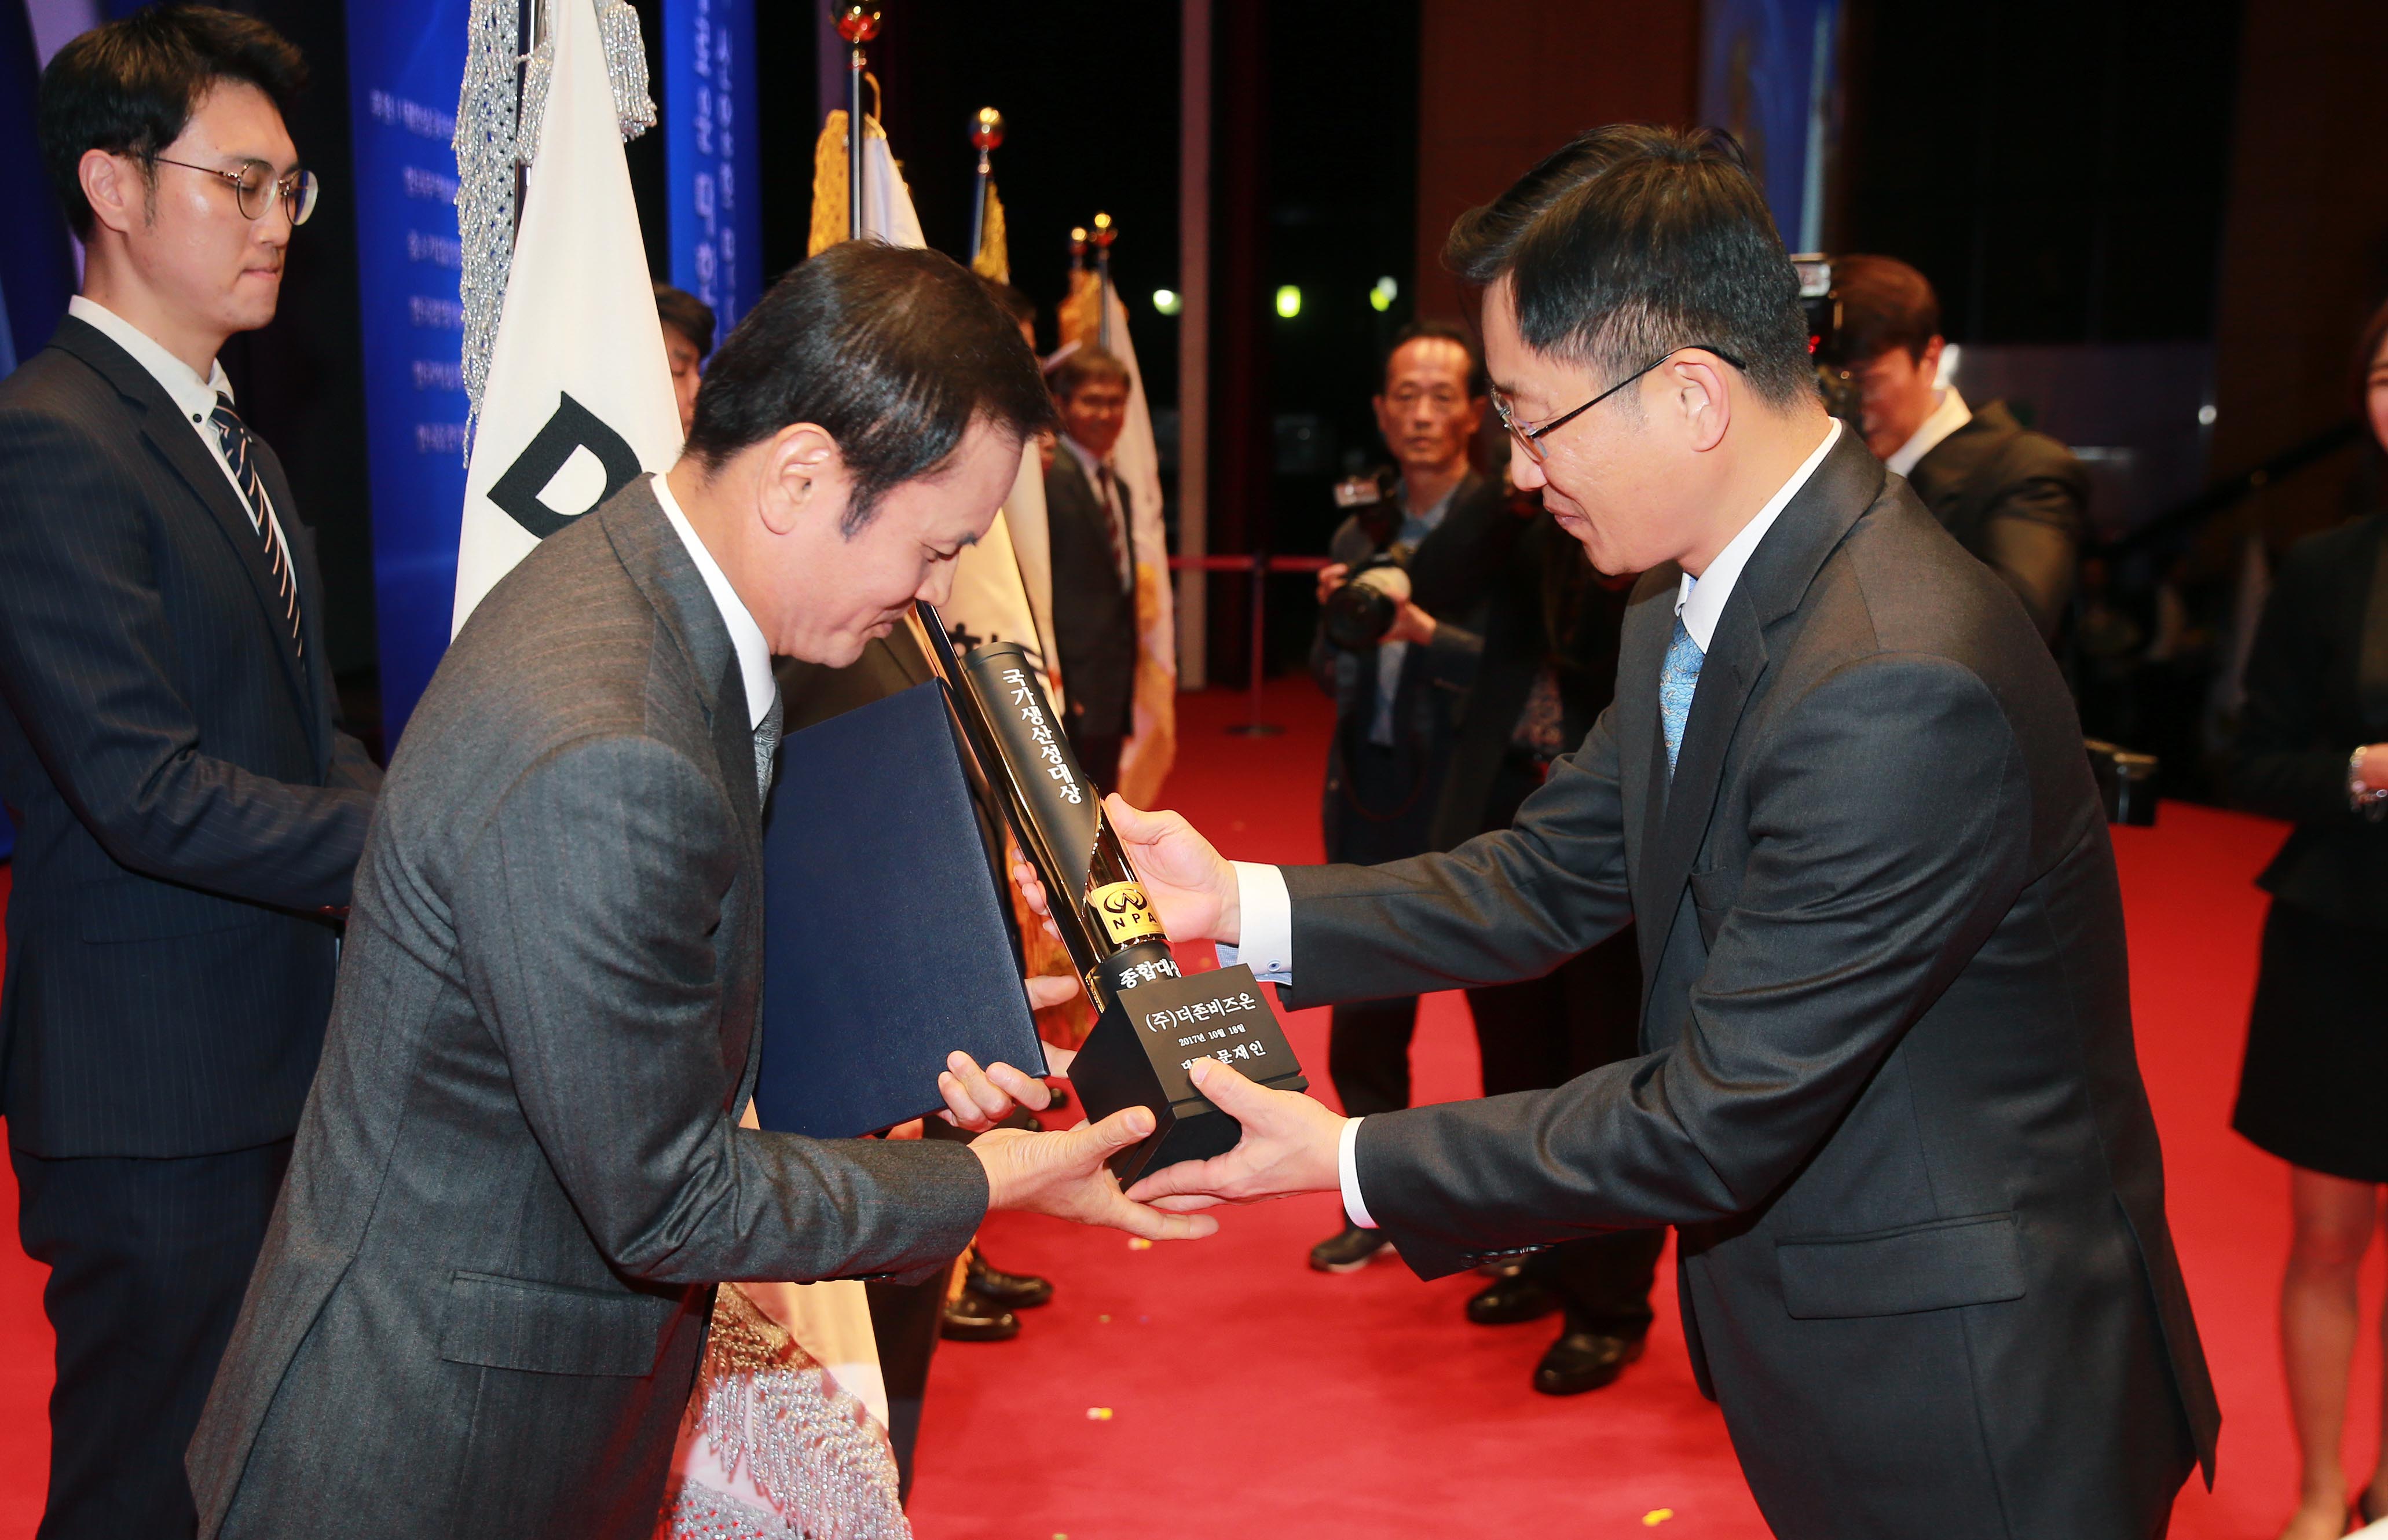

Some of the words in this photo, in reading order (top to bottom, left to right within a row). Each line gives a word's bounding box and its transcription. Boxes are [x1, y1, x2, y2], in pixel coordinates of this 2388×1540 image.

[1002, 668, 1083, 805] 국가생산성대상
[1113, 912, 1158, 930] NPA
[1119, 958, 1182, 989] 종합대상
[1145, 992, 1257, 1032] (주)더존비즈온
[1178, 1033, 1206, 1047] 2017년
[1208, 1028, 1226, 1040] 10월
[1228, 1023, 1246, 1036] 18일
[1217, 1040, 1267, 1065] 문재인
